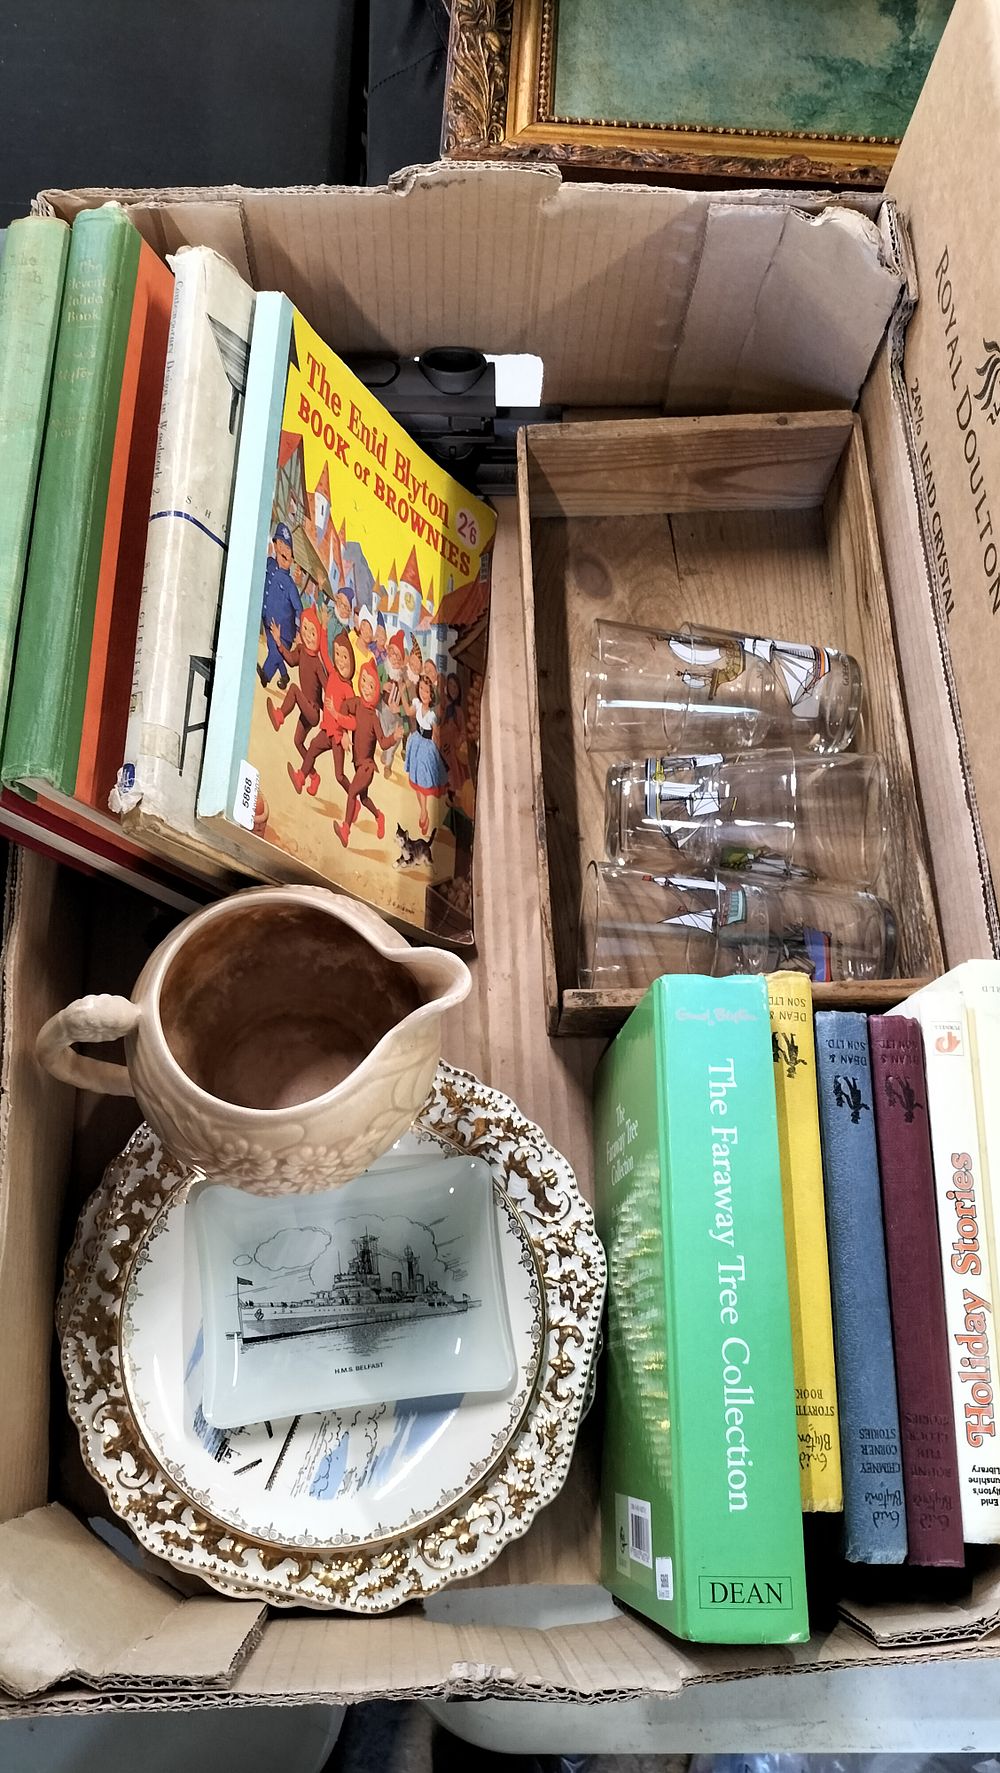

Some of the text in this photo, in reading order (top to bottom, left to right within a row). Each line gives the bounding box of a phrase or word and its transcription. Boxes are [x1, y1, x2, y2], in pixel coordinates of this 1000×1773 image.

[935, 244, 963, 392] ROYAL
[956, 384, 1000, 616] DOULTON
[306, 351, 450, 529] The Enid Blyton
[297, 392, 471, 577] BOOK of BROWNIES
[919, 441, 937, 509] LEAD
[931, 511, 955, 625] CRYSTAL
[242, 777, 253, 809] 5868
[787, 997, 807, 1007] SON
[779, 1011, 807, 1022] DEAN
[825, 1038, 866, 1051] SON LTD.
[828, 1053, 867, 1067] DEAN &
[615, 1102, 626, 1128] The
[606, 1117, 639, 1166] Faraway Tree
[610, 1154, 635, 1187] Collection
[708, 1057, 755, 1513] The Faraway Tree Collection
[946, 1152, 996, 1448] Holiday Stories
[355, 1362, 383, 1371] BELFAST
[795, 1388, 823, 1400] BOOK
[859, 1428, 897, 1440] STORIES
[861, 1444, 898, 1456] CORNER
[799, 1450, 828, 1472] Enid
[859, 1461, 901, 1474] CHIMNEY
[971, 1464, 1000, 1475] Library
[968, 1477, 1000, 1486] unshine
[972, 1486, 1000, 1496] lyton's
[864, 1487, 904, 1508] Blyton's
[981, 1498, 999, 1507] Enid
[872, 1510, 900, 1529] Enid
[709, 1581, 784, 1605] DEAN
